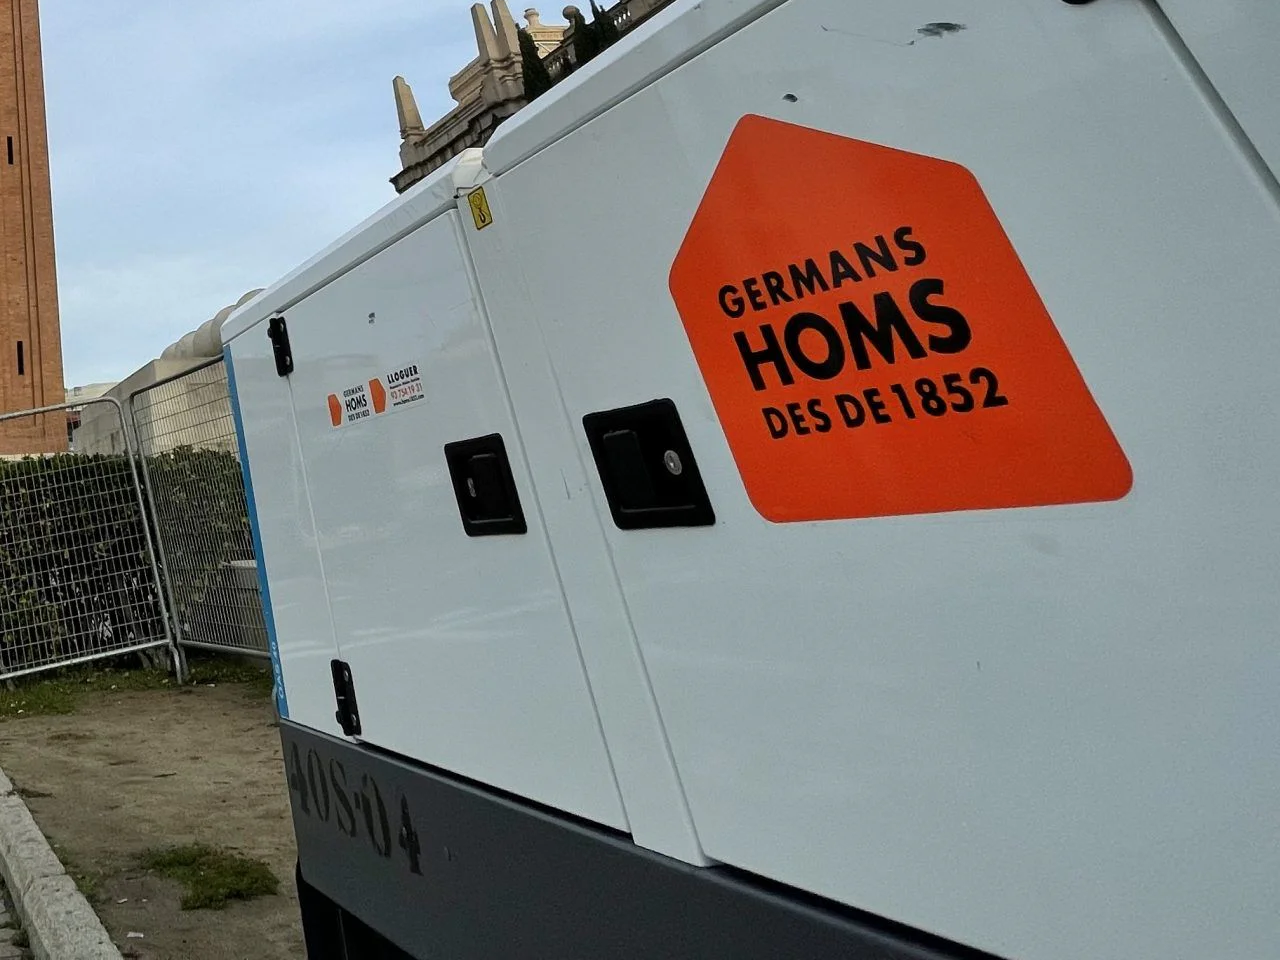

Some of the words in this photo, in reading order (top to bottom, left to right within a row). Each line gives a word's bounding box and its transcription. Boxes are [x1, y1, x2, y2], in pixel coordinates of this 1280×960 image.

[718, 226, 927, 319] GERMANS
[733, 278, 973, 392] HOMS
[343, 385, 364, 398] GERMANS
[386, 365, 419, 384] LLOGUER
[344, 394, 368, 413] HOMS
[761, 398, 831, 440] DES
[835, 387, 892, 429] DE
[890, 367, 1009, 420] 1852
